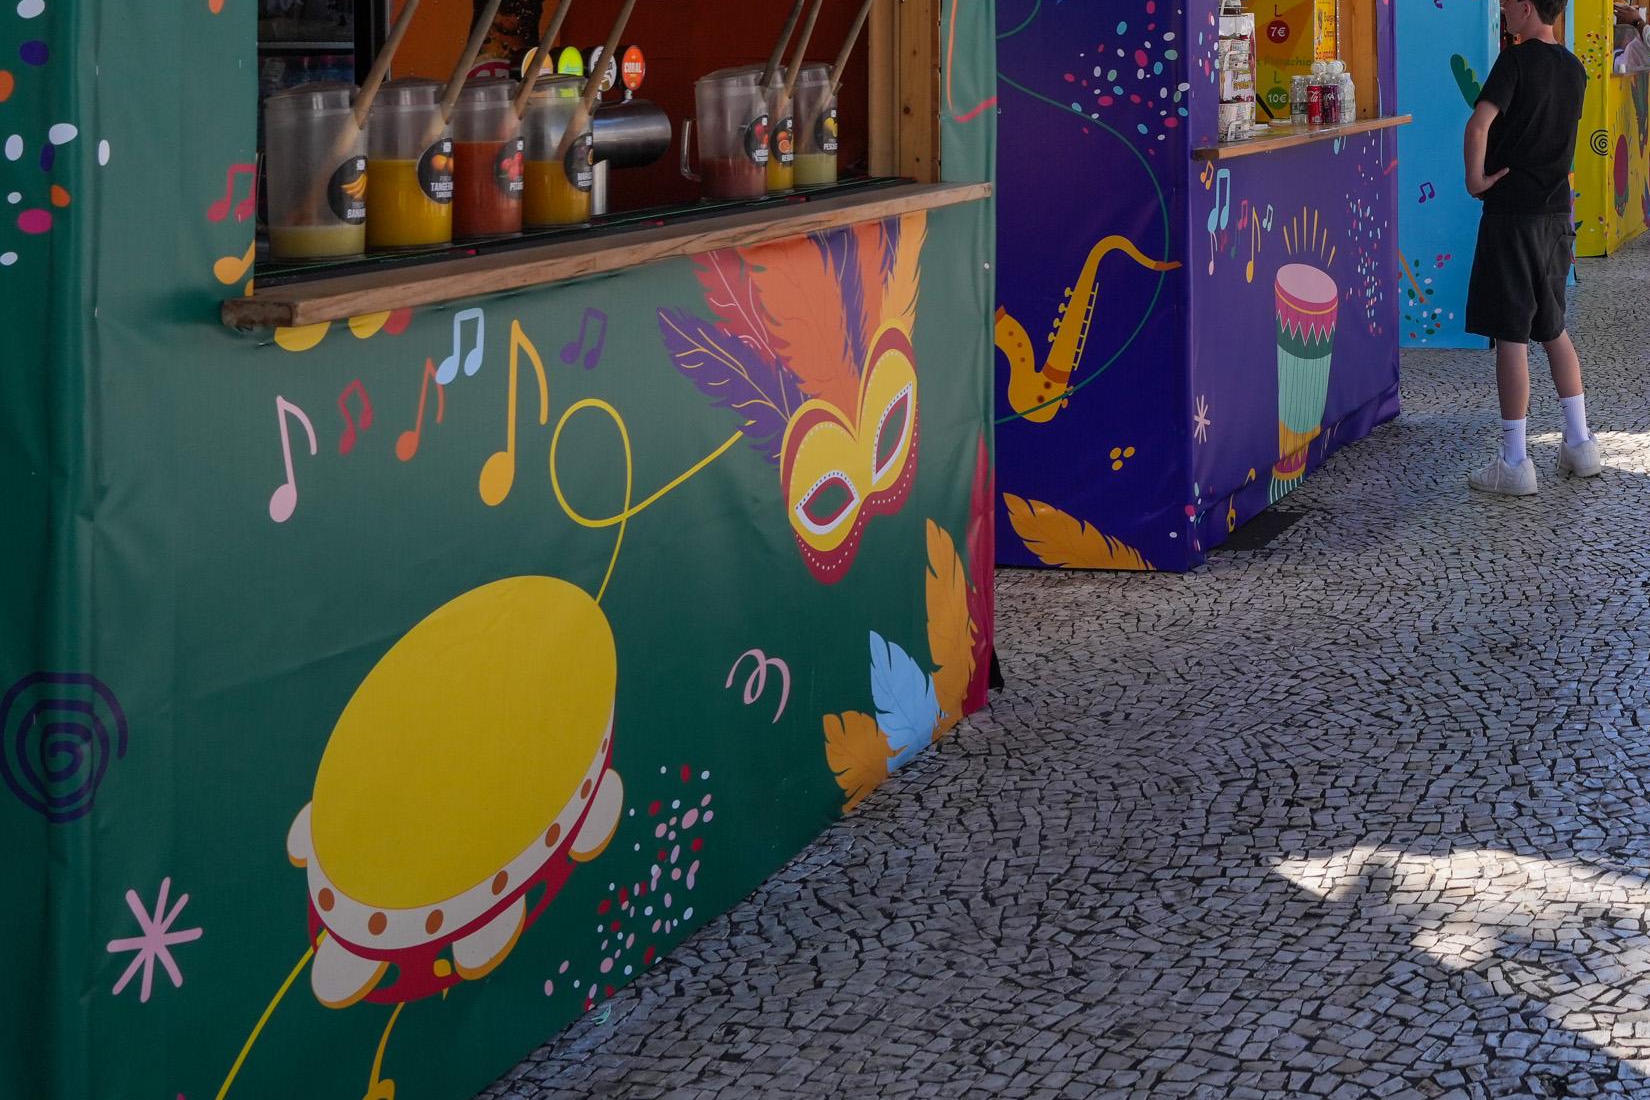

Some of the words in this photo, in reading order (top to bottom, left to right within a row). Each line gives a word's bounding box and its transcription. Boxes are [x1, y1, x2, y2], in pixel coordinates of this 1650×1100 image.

[1274, 4, 1282, 17] L
[1269, 26, 1288, 38] 7€
[623, 62, 643, 73] CORAL
[1273, 71, 1281, 84] L
[1267, 93, 1288, 104] 10€
